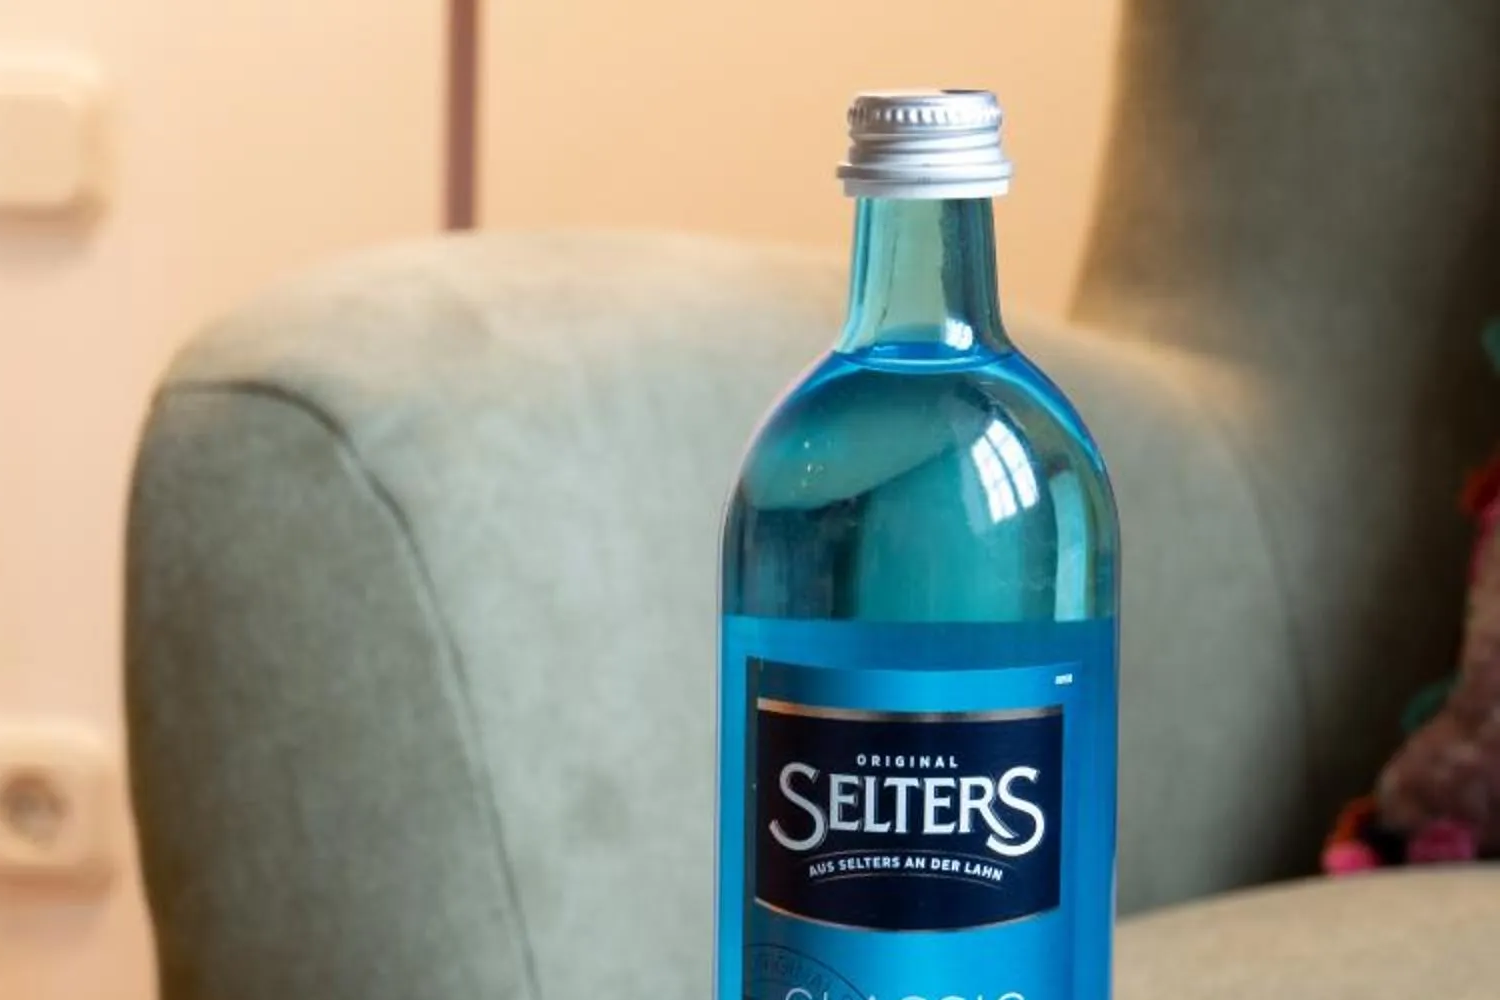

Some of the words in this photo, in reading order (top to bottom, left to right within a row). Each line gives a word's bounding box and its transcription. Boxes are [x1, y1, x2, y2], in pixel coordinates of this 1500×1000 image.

[856, 753, 959, 769] ORIGINAL
[768, 761, 1046, 857] SELTERS
[808, 860, 836, 878] AUS
[838, 856, 901, 873] SELTERS
[904, 856, 926, 871] AN
[930, 857, 962, 874] DER
[964, 861, 1003, 882] LAHN
